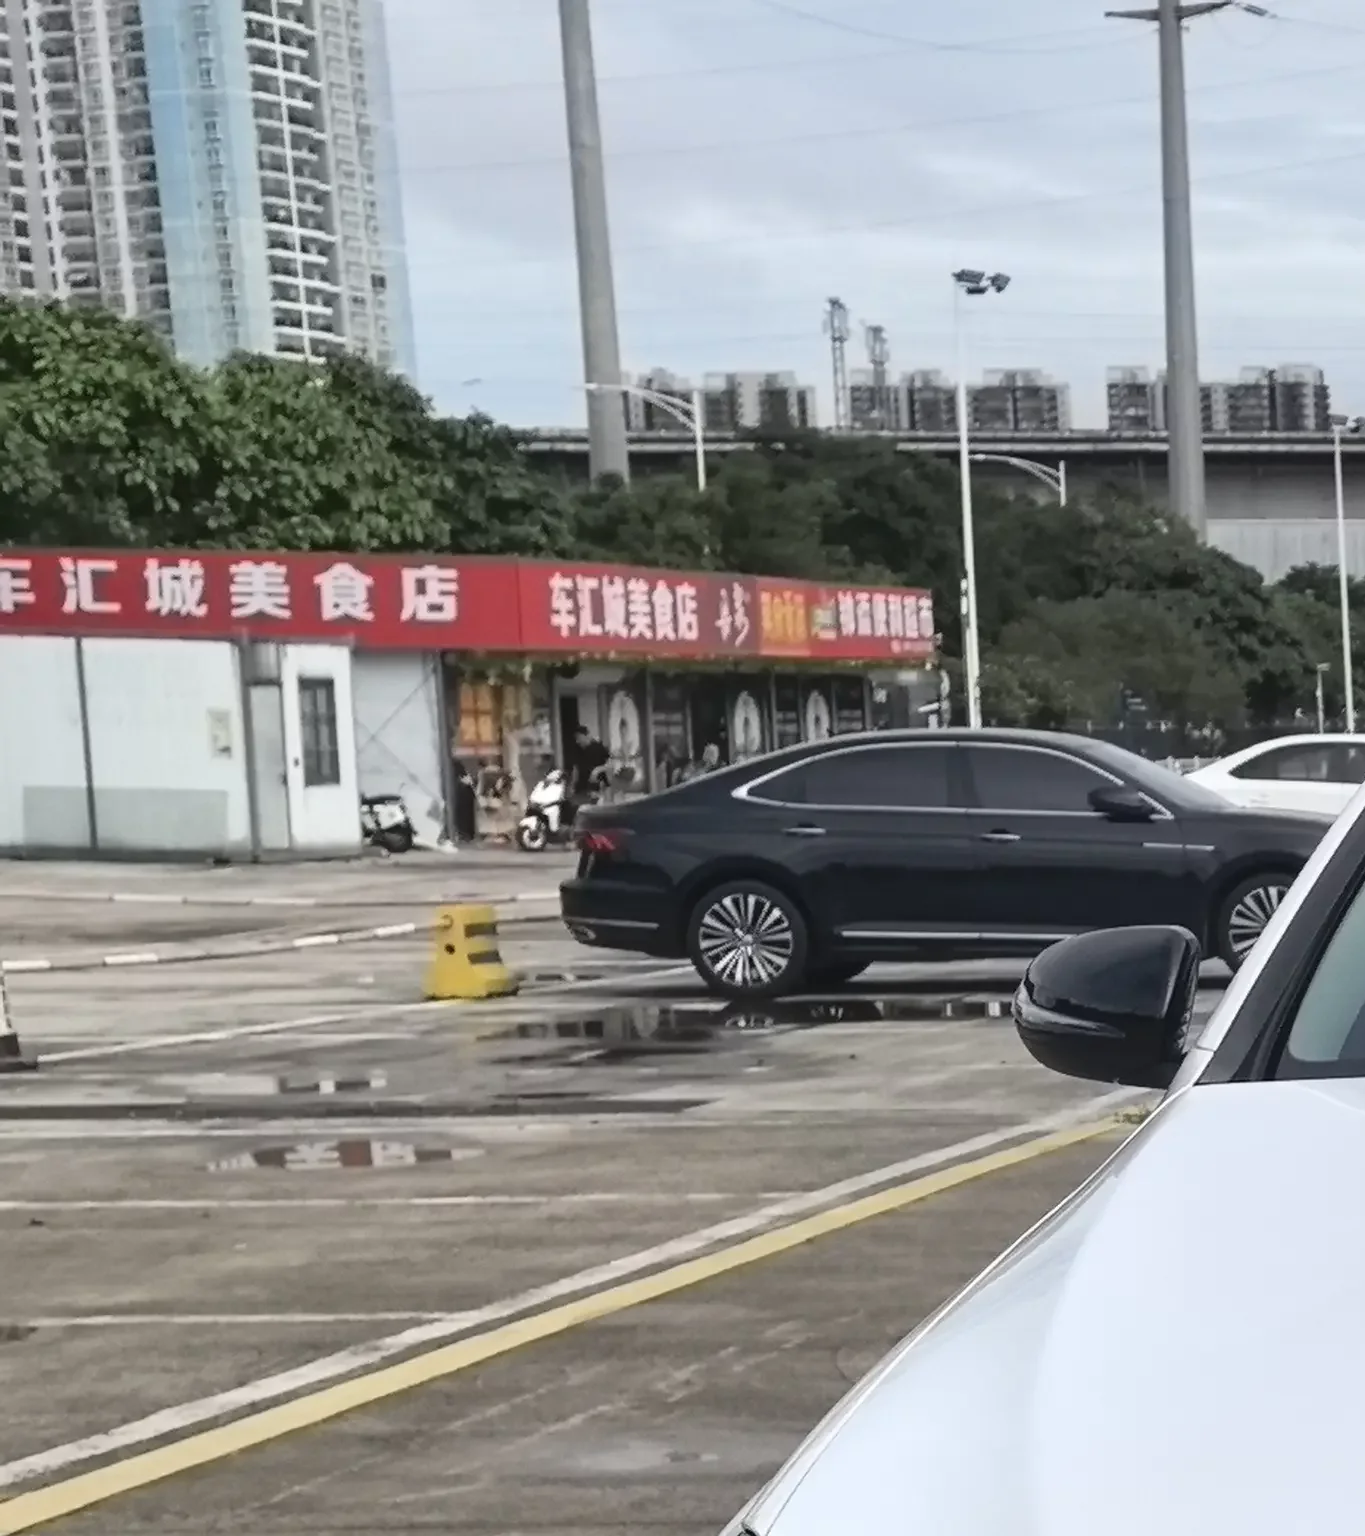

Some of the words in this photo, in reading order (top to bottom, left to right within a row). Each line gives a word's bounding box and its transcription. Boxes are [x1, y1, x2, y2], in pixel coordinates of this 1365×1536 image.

[0, 556, 459, 622] 车汇城美食店
[548, 571, 699, 642] 车汇城美食店
